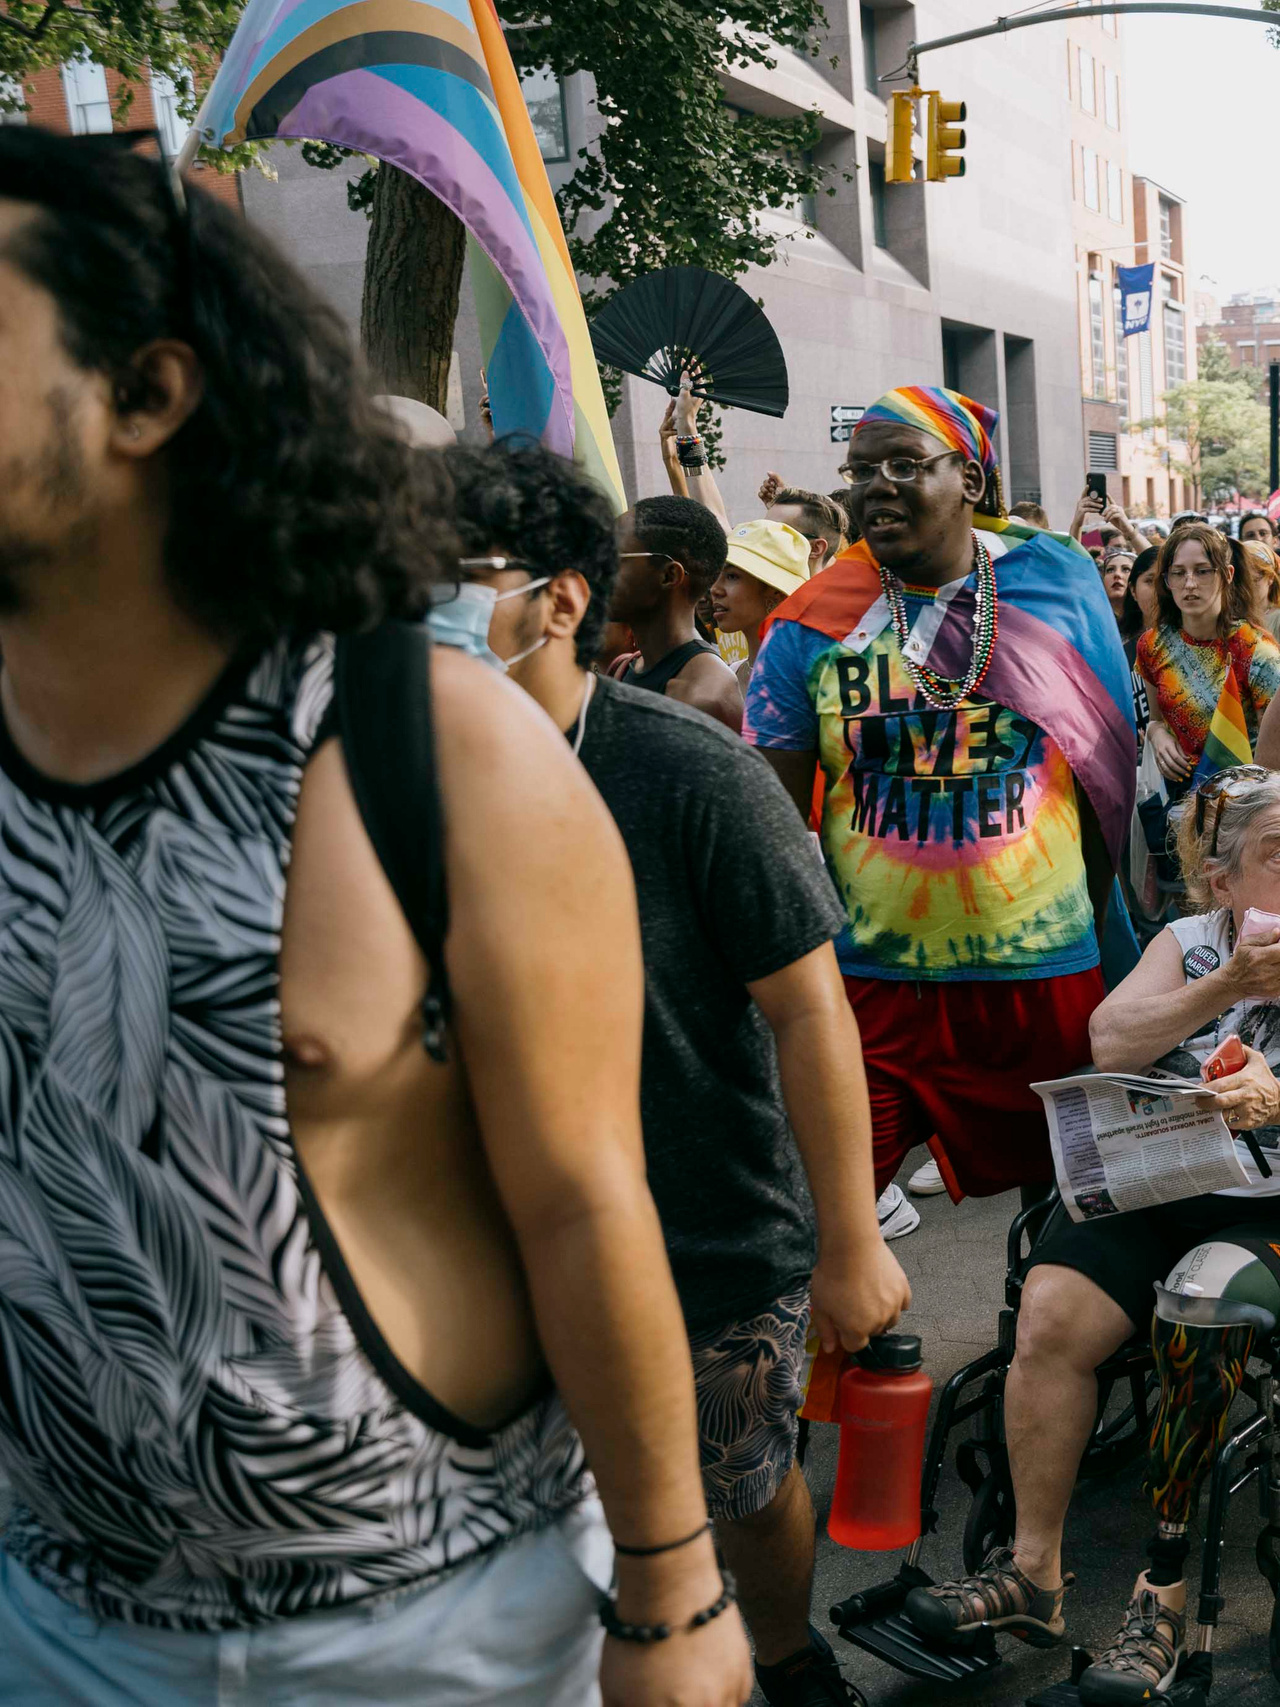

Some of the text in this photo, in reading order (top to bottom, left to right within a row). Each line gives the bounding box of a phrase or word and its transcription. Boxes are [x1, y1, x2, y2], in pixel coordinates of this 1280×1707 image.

[845, 705, 1034, 777] LIVES
[850, 772, 1028, 842] MATTER
[1194, 946, 1219, 966] QUEER
[1185, 957, 1211, 976] MARCH
[1144, 1119, 1160, 1131] fight
[1160, 1118, 1168, 1126] to
[1168, 1112, 1195, 1124] mobilize
[1126, 1122, 1143, 1134] Israeli
